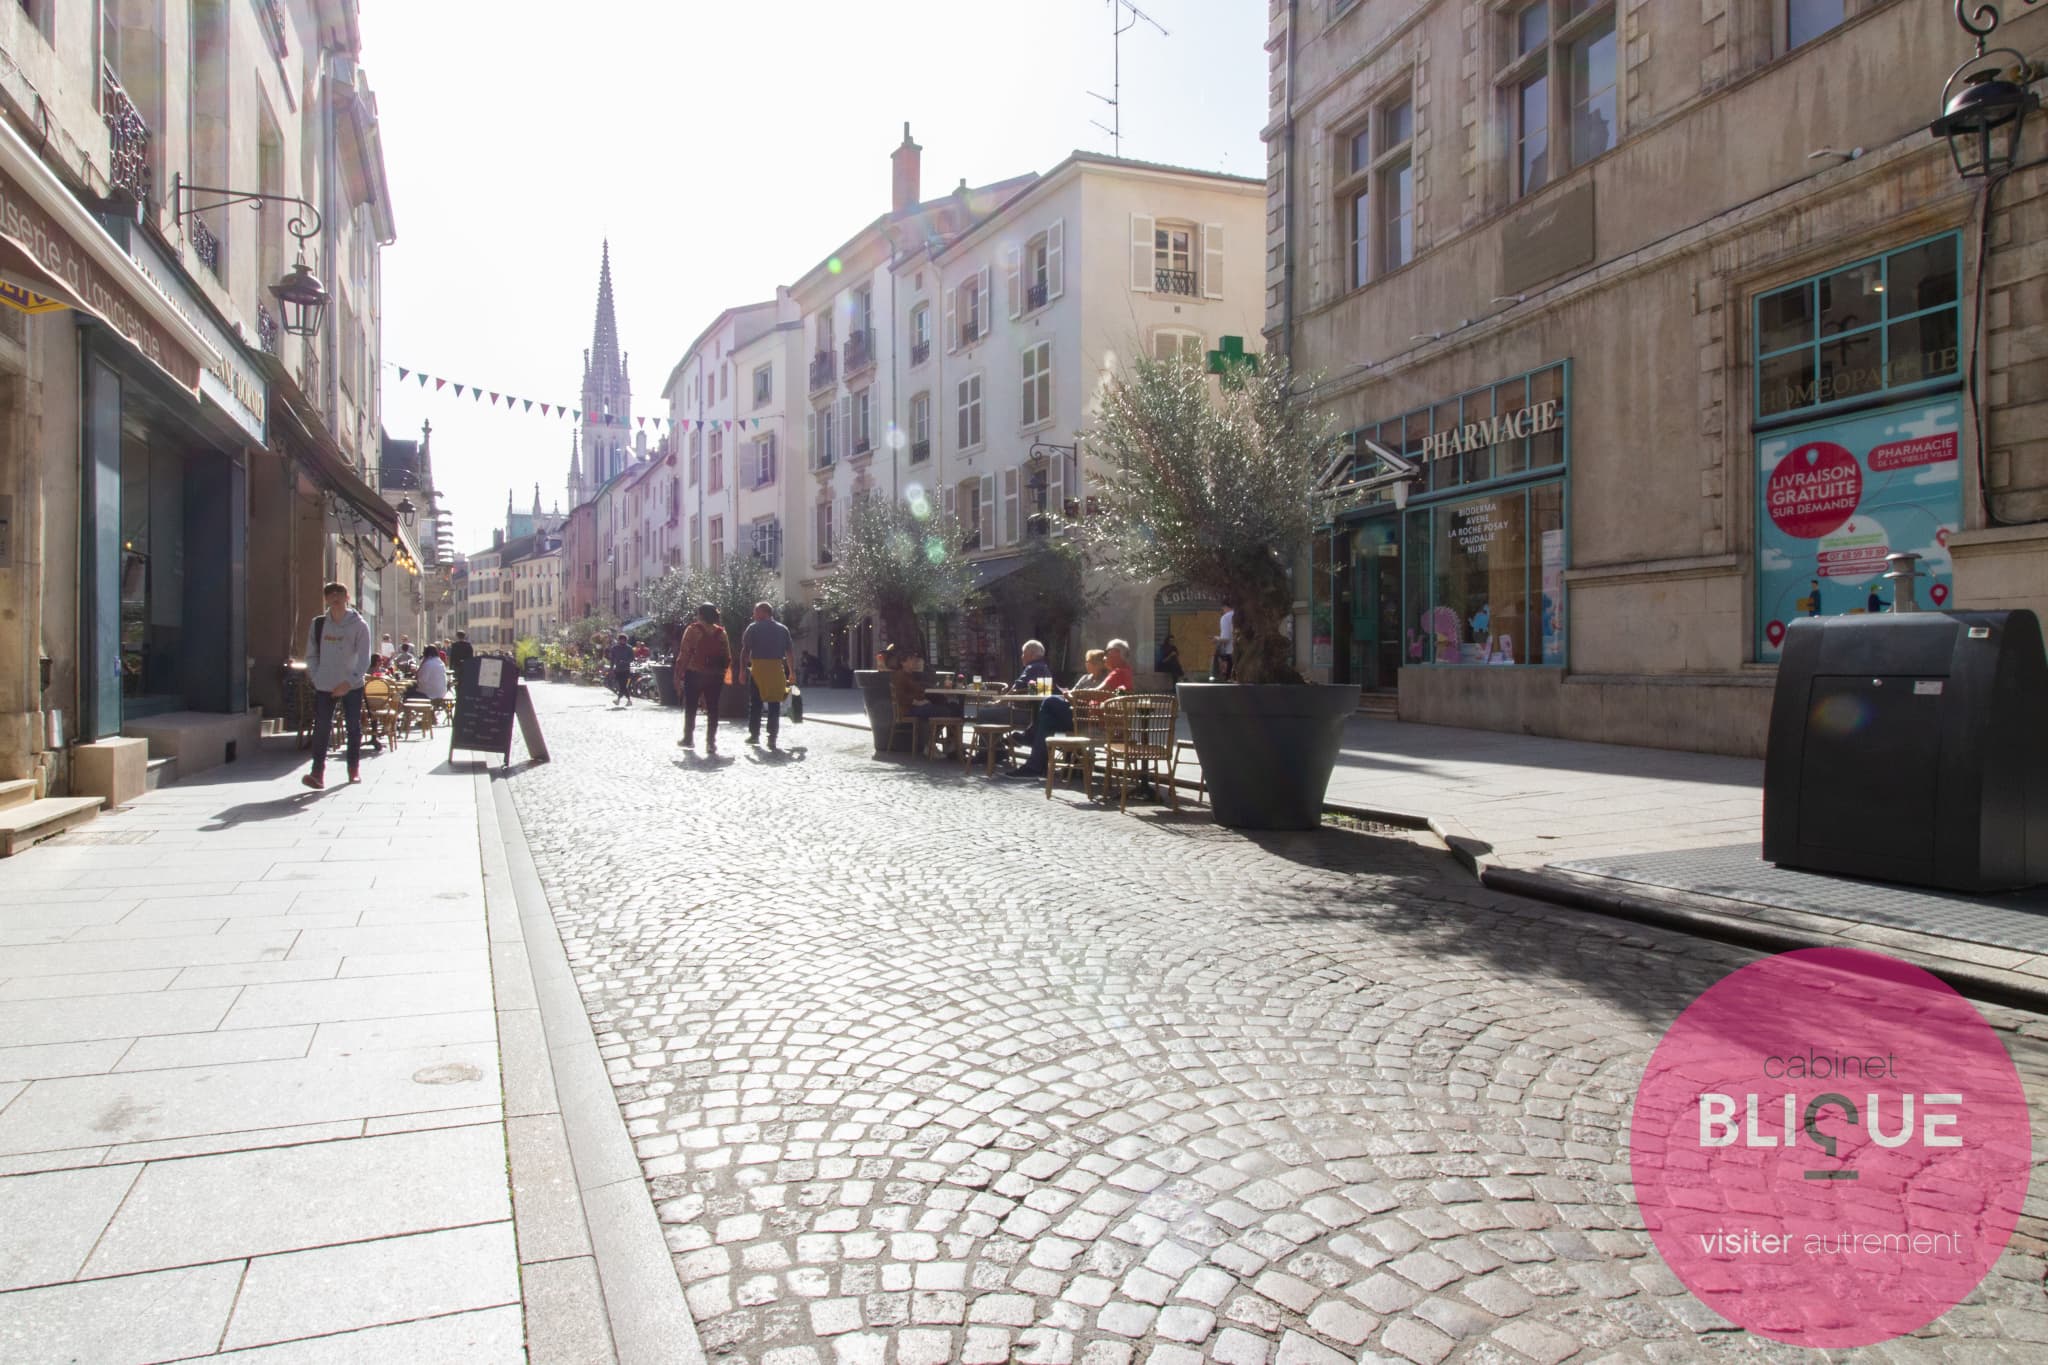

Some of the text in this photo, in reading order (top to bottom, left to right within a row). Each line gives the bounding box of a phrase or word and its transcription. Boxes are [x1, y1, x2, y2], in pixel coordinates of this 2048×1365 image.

[83, 256, 160, 361] l'ancienne
[1422, 400, 1557, 463] PHARMACIE
[1877, 438, 1953, 460] PHARMACIE
[1930, 449, 1953, 458] VILLE
[1772, 464, 1856, 490] LIVRAISON
[1772, 480, 1856, 505] GRATUITE
[1772, 497, 1856, 518] SUR DEMANDE
[1448, 520, 1509, 538] LA ROCHE POSAY
[1459, 533, 1495, 545] CAUDALIE
[1467, 544, 1488, 553] NUXE
